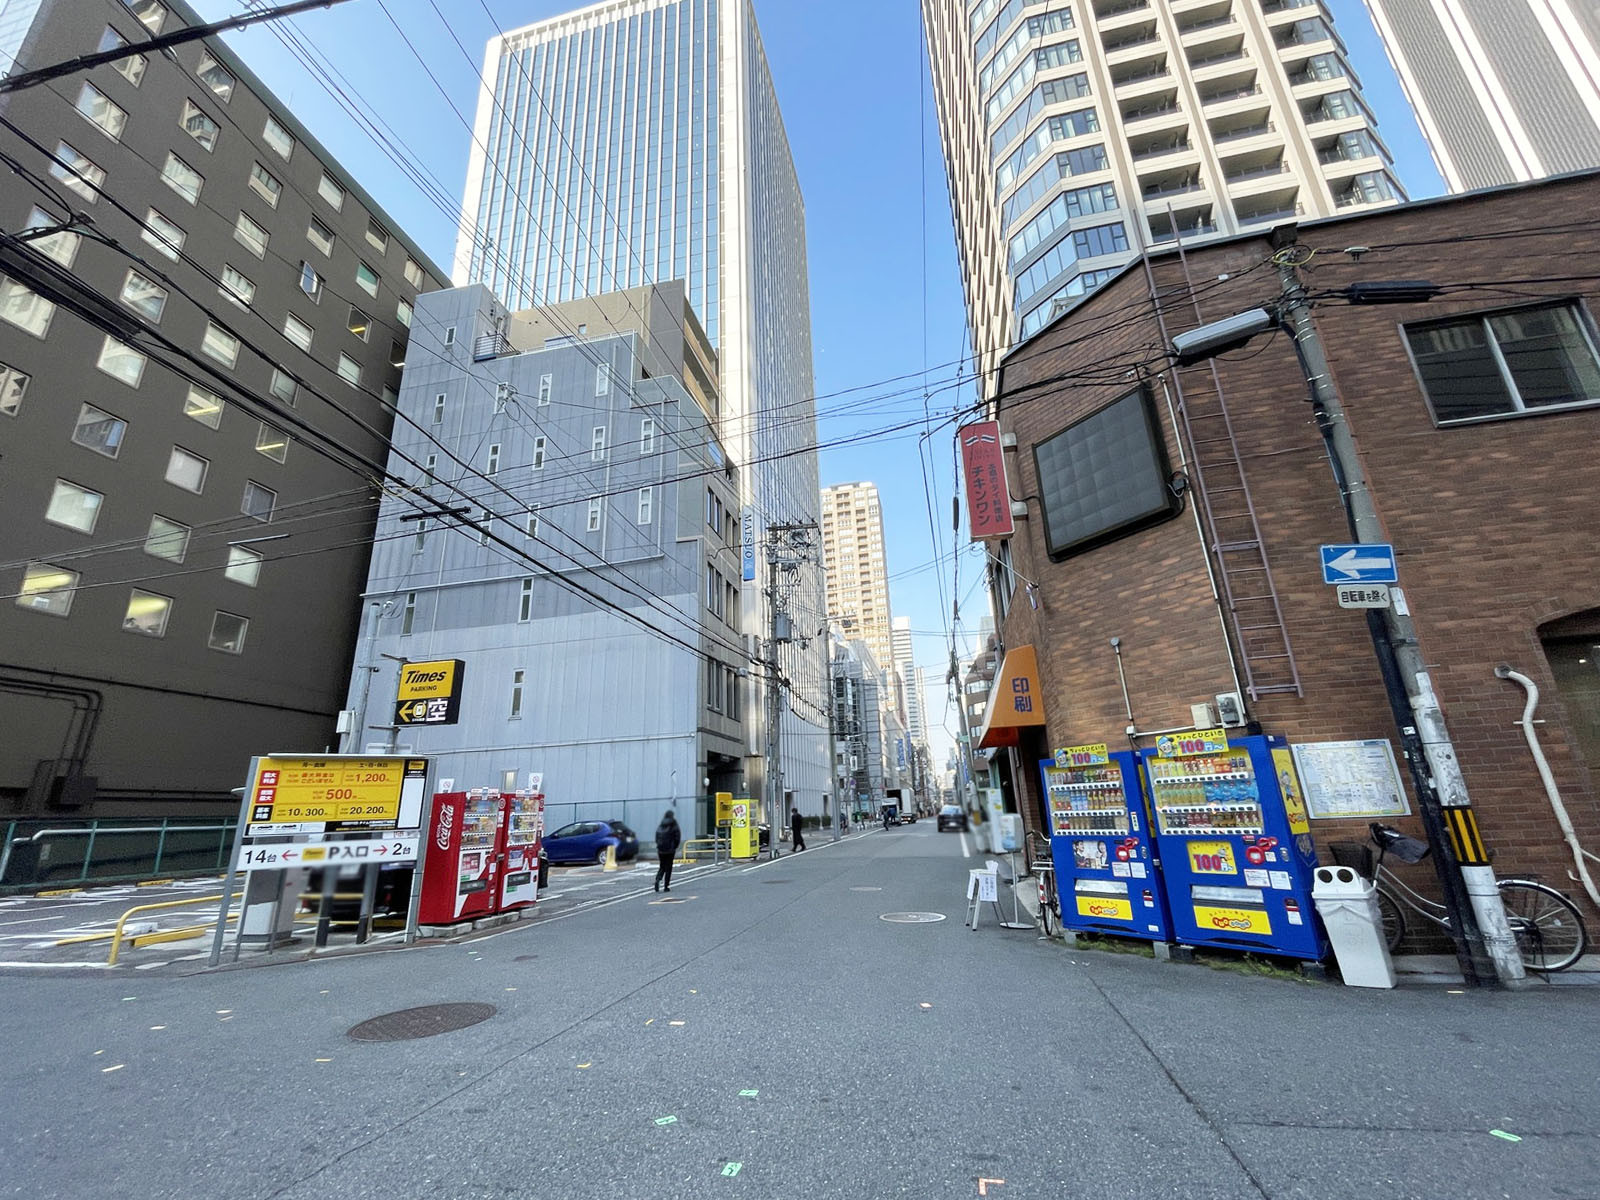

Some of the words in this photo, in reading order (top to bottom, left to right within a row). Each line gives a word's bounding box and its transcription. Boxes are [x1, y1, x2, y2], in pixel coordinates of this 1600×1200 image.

[972, 465, 990, 526] チキンワン
[744, 514, 752, 559] MATSUO
[405, 670, 447, 684] Times
[1012, 677, 1032, 712] 印刷
[426, 698, 448, 722] 空
[355, 773, 386, 783] 1,200
[326, 788, 353, 800] 500
